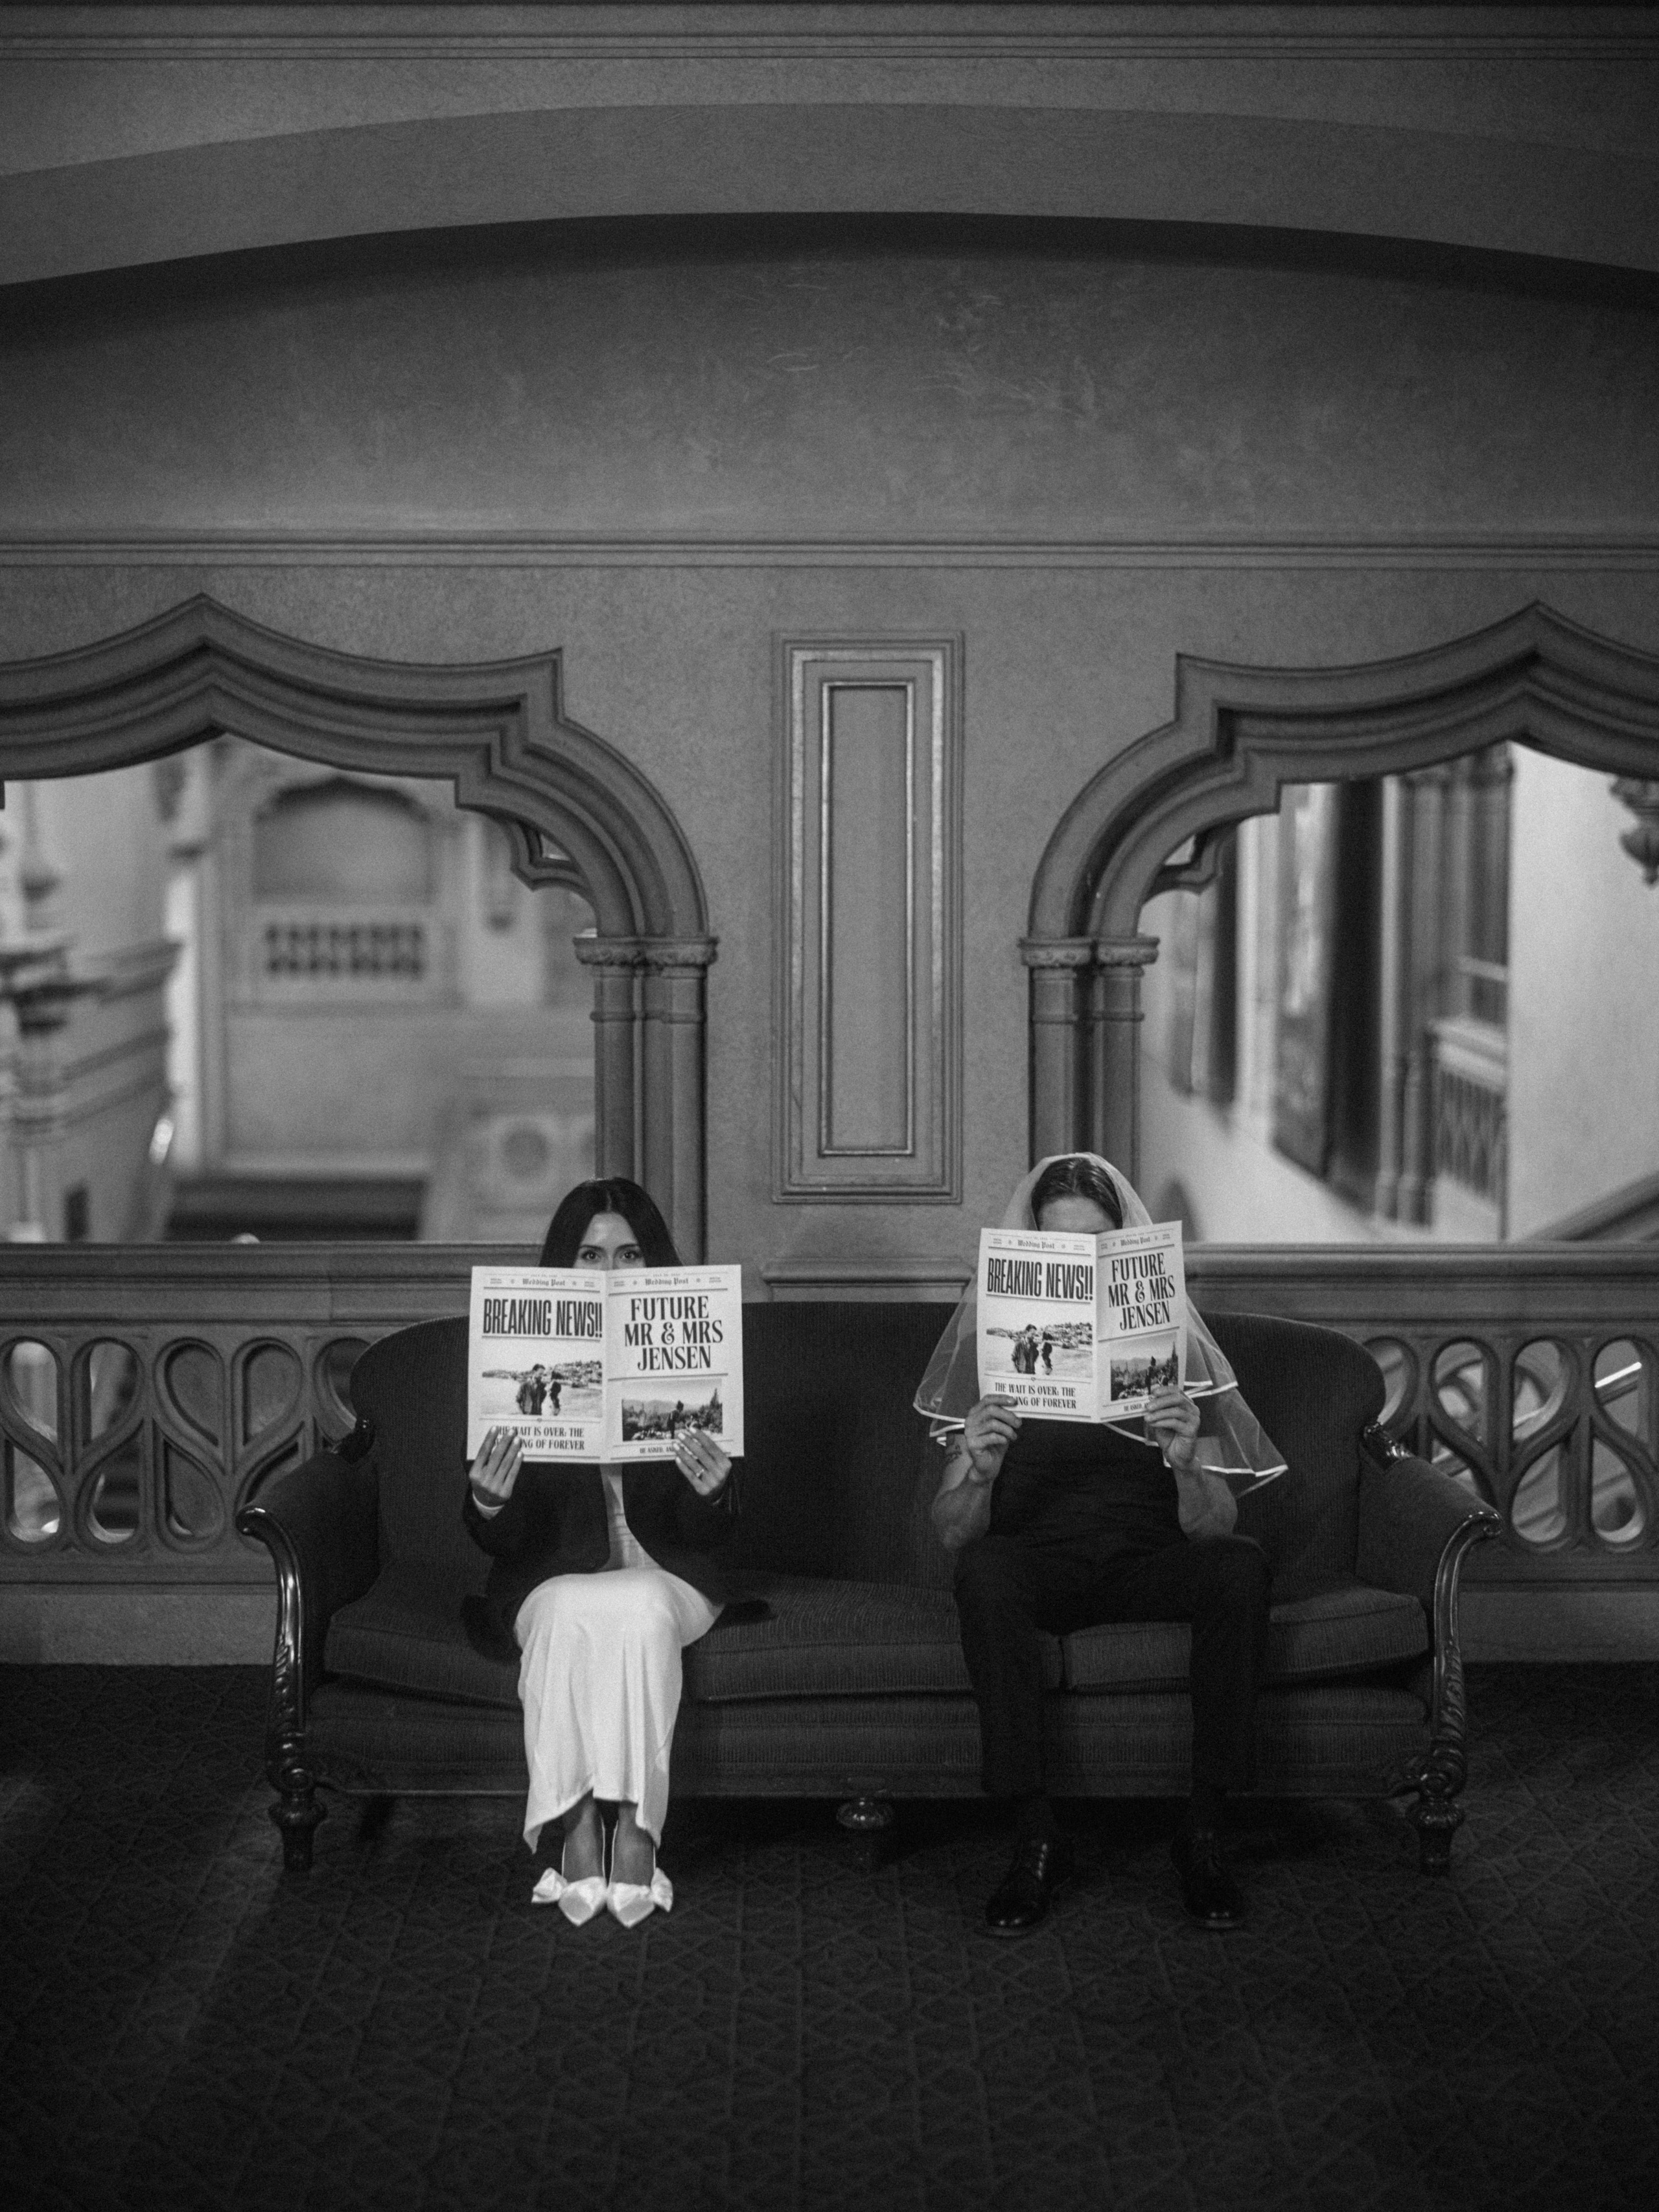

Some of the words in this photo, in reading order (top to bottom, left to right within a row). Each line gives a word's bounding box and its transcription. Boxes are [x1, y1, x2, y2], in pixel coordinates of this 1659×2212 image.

[1017, 1239, 1040, 1248] Wedding
[987, 1257, 1042, 1297] BREAKING
[1046, 1263, 1093, 1301] NEWS!!
[1111, 1252, 1165, 1283] FUTURE
[1108, 1283, 1130, 1308] MR
[1135, 1280, 1145, 1303] &
[1149, 1275, 1176, 1301] MRS
[483, 1299, 551, 1335] BREAKING
[556, 1300, 602, 1338] NEWS!!
[631, 1296, 709, 1321] FUTURE
[1120, 1300, 1170, 1331] JENSEN
[625, 1323, 653, 1347] MR
[661, 1321, 675, 1345] &
[682, 1320, 723, 1344] MRS
[637, 1345, 711, 1371] JENSEN
[995, 1382, 1006, 1392] THE
[1008, 1383, 1027, 1394] WAIT
[1028, 1385, 1036, 1394] IS
[1062, 1386, 1076, 1397] THE
[1030, 1397, 1041, 1406] OF
[1043, 1397, 1076, 1408] FOREVER
[533, 1426, 541, 1436] IS
[570, 1427, 584, 1437] THE
[536, 1439, 546, 1449] OF
[549, 1439, 585, 1450] FOREVER
